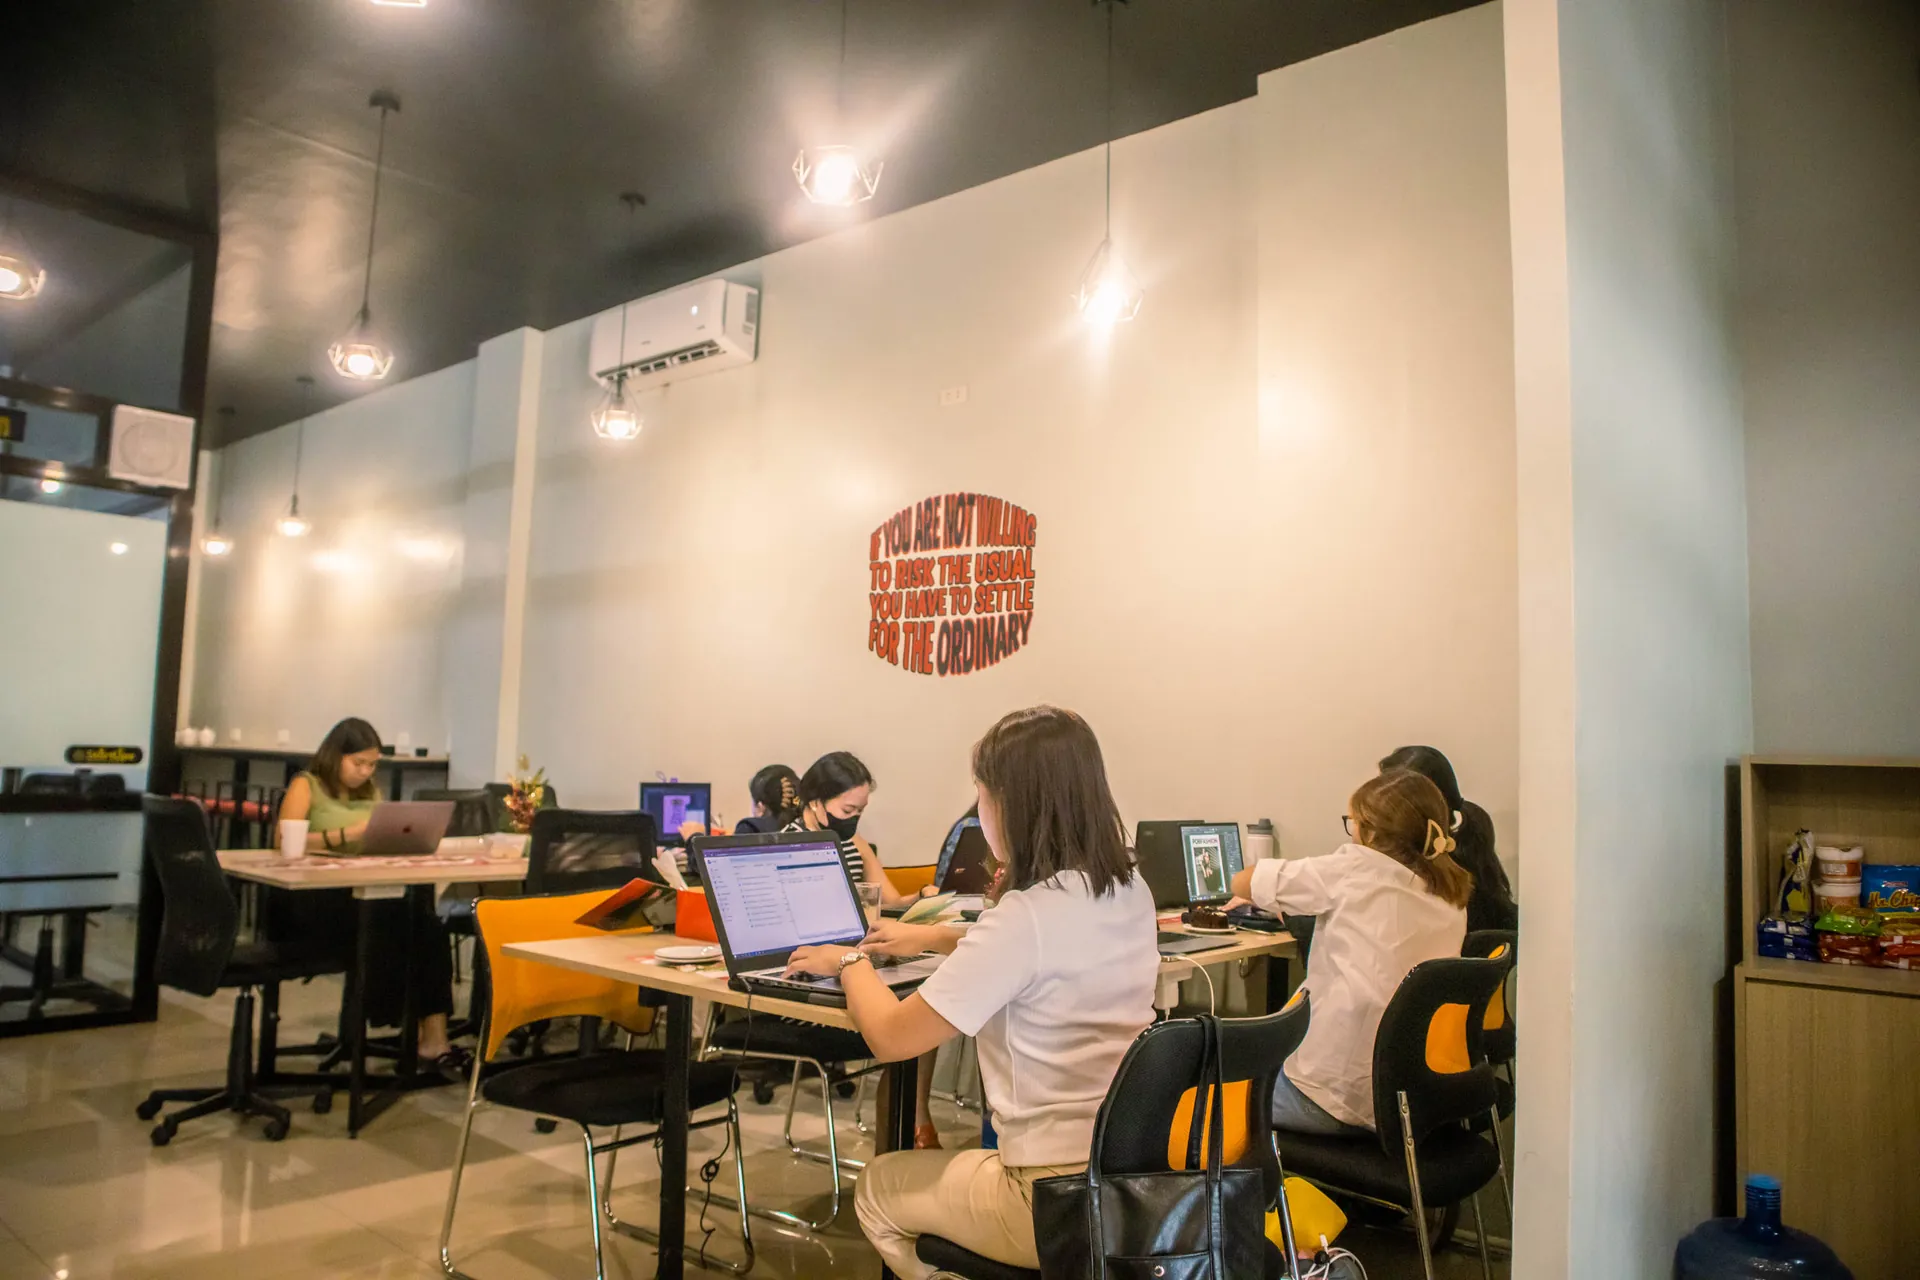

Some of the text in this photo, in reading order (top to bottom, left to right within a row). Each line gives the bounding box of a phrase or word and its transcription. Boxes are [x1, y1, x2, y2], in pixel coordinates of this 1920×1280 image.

[870, 492, 1037, 561] IF YOU ARE NOT WILLING
[869, 547, 1035, 591] TO RISK THE USUAL
[869, 581, 1035, 620] YOU HAVE TO SETTLE
[869, 610, 1033, 677] FOR THE ORDINARY
